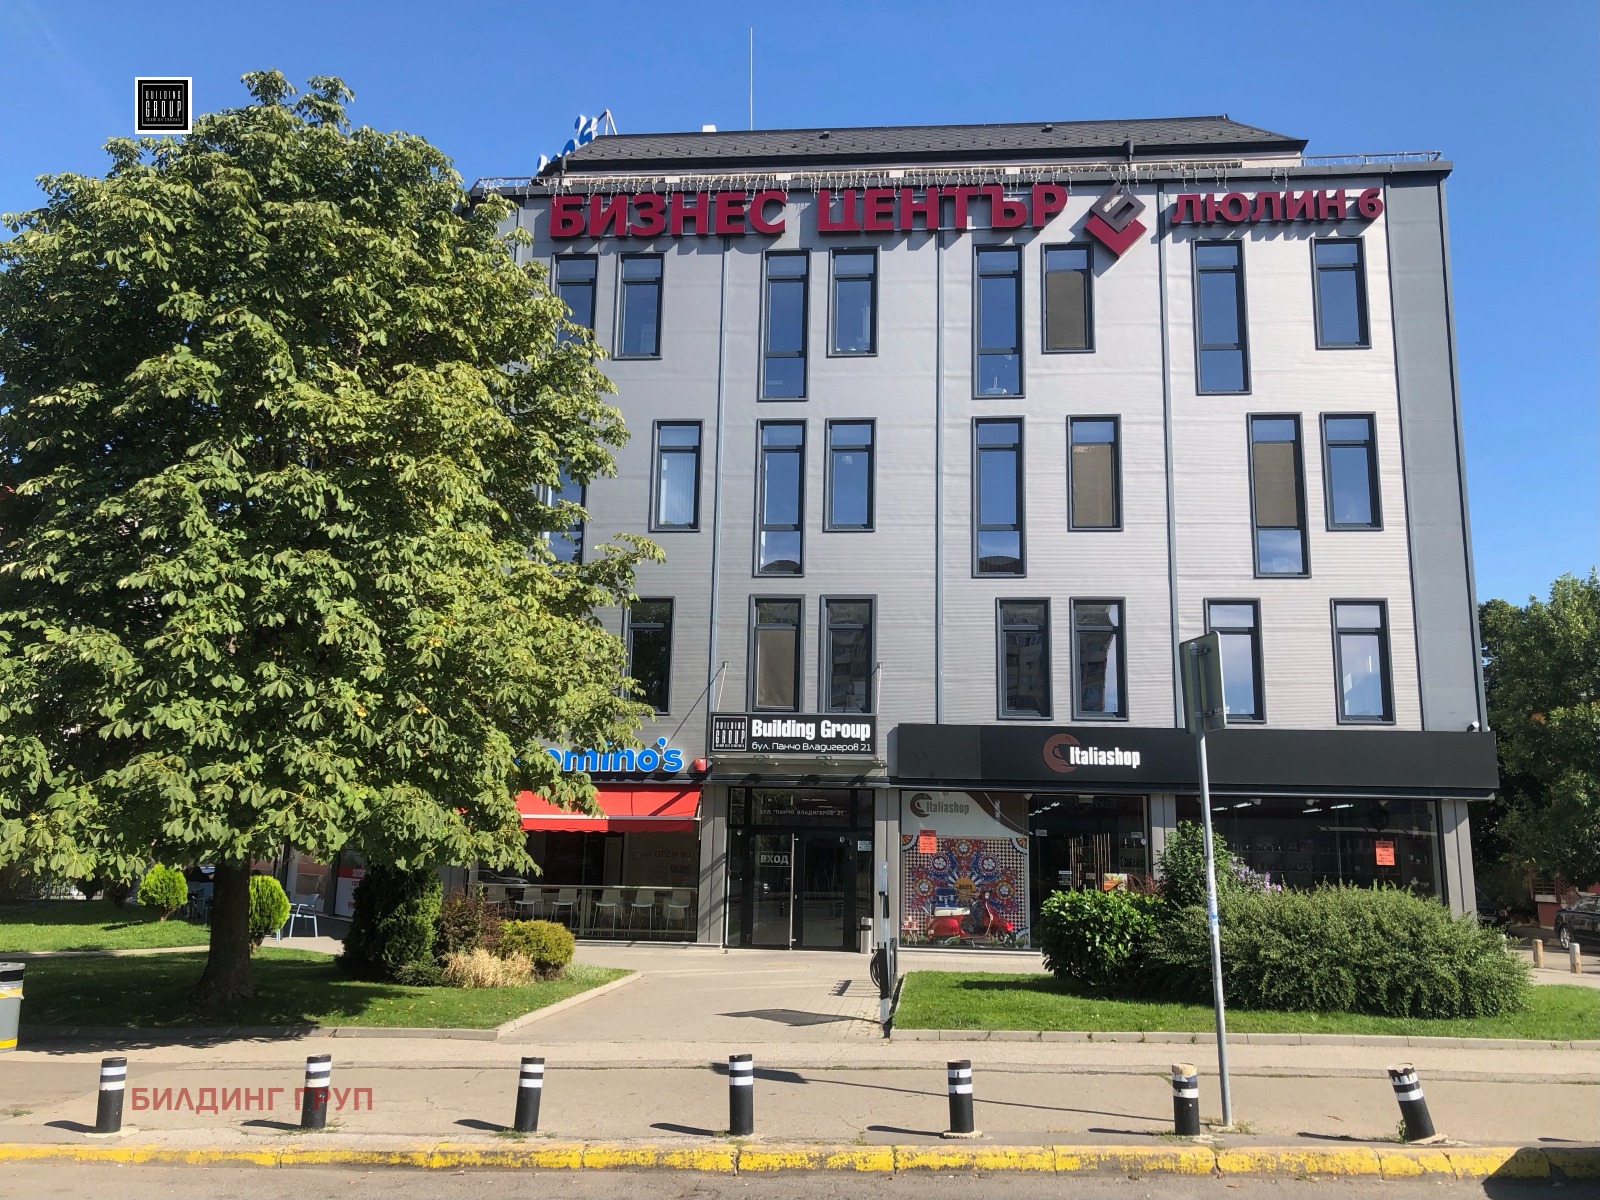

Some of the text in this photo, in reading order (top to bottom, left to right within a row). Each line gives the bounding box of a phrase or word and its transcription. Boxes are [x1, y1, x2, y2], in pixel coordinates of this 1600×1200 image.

[550, 184, 1384, 240] БИЗНЕС ЦЕНТЪР ЛЮЛИН 6
[715, 729, 746, 744] GROUP
[751, 719, 871, 742] Building Group
[513, 737, 685, 772] mino's
[751, 741, 771, 751] бул.
[772, 742, 801, 751] Панчо
[802, 742, 860, 753] Владигеров
[860, 743, 872, 752] 21
[1069, 746, 1141, 769] Italiashop
[926, 800, 970, 816] Italiashop
[760, 854, 789, 865] ВХОД
